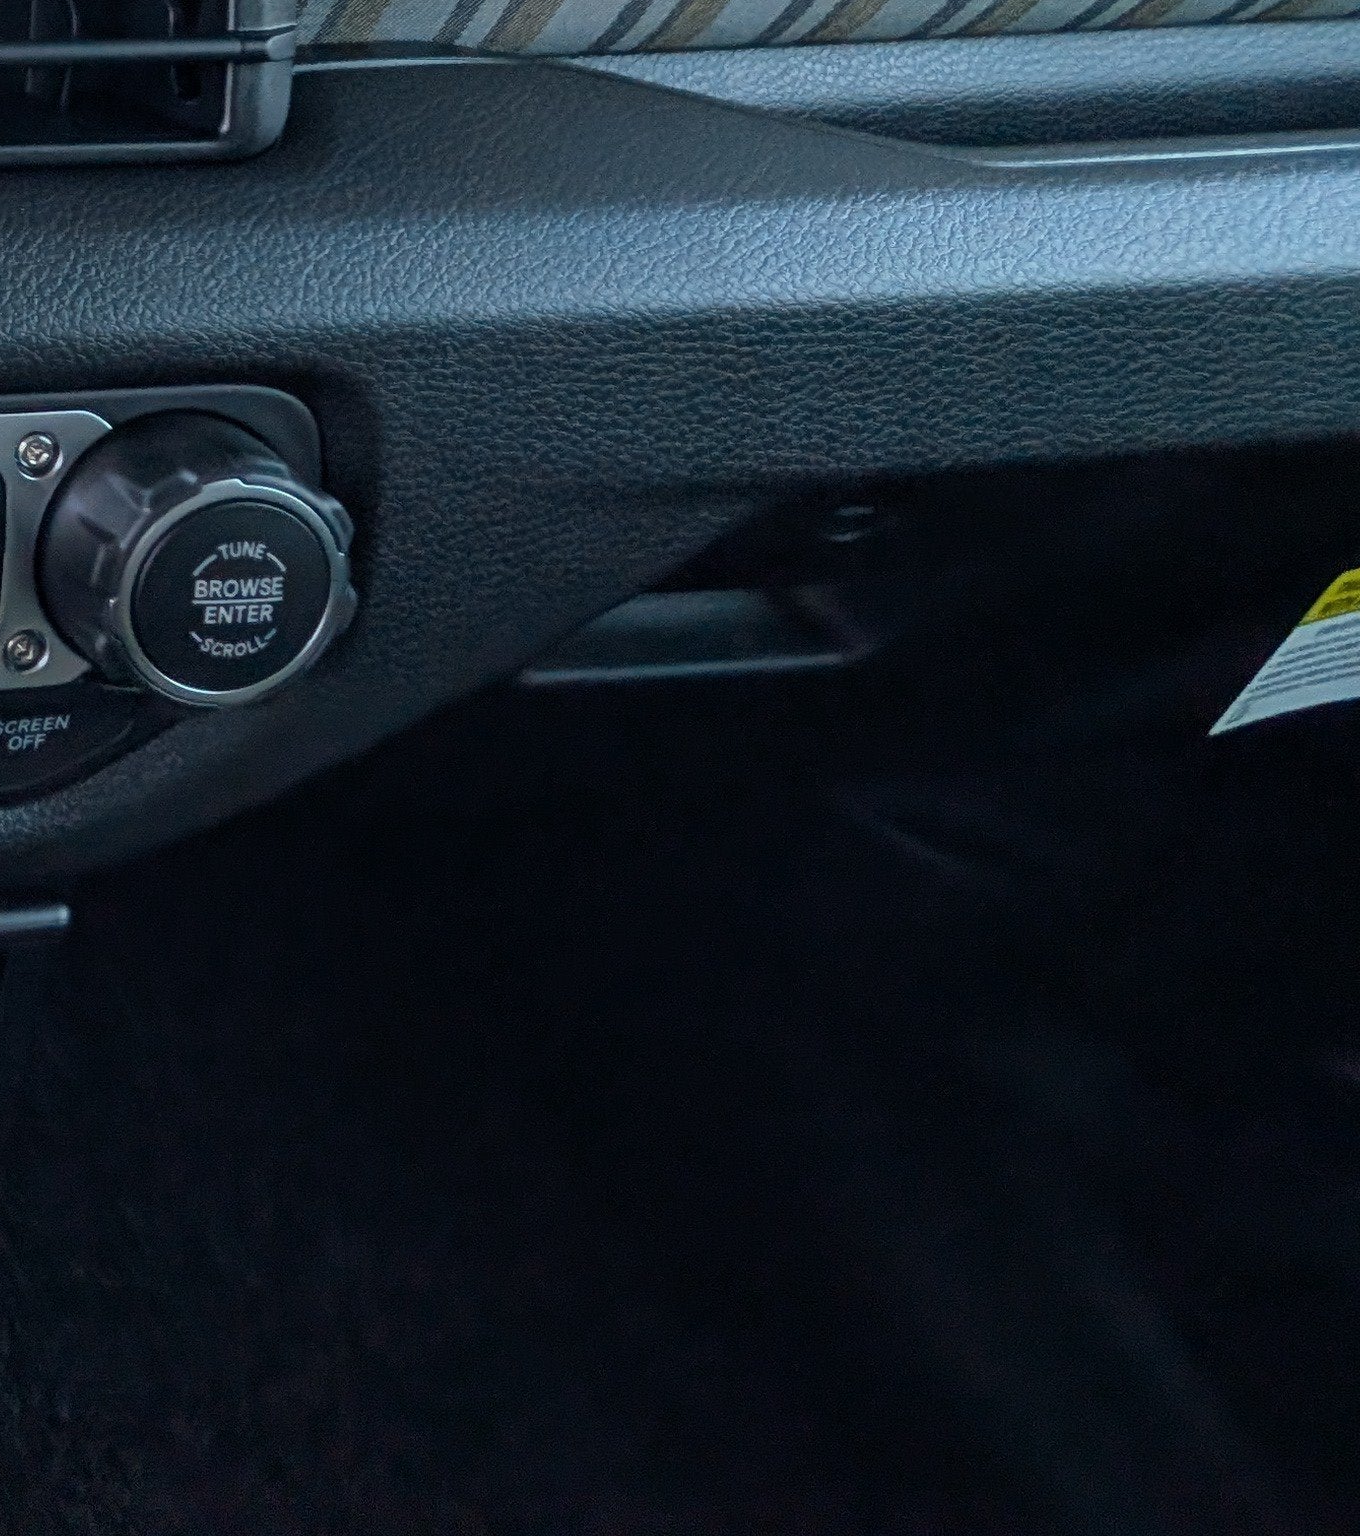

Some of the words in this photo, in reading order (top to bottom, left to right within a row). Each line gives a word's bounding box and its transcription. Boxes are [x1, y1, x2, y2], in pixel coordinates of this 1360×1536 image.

[216, 540, 268, 562] TUNE
[192, 575, 285, 600] BROWSE
[203, 603, 275, 626] ENTER
[199, 634, 267, 659] SCROLL
[8, 731, 47, 752] OFF
